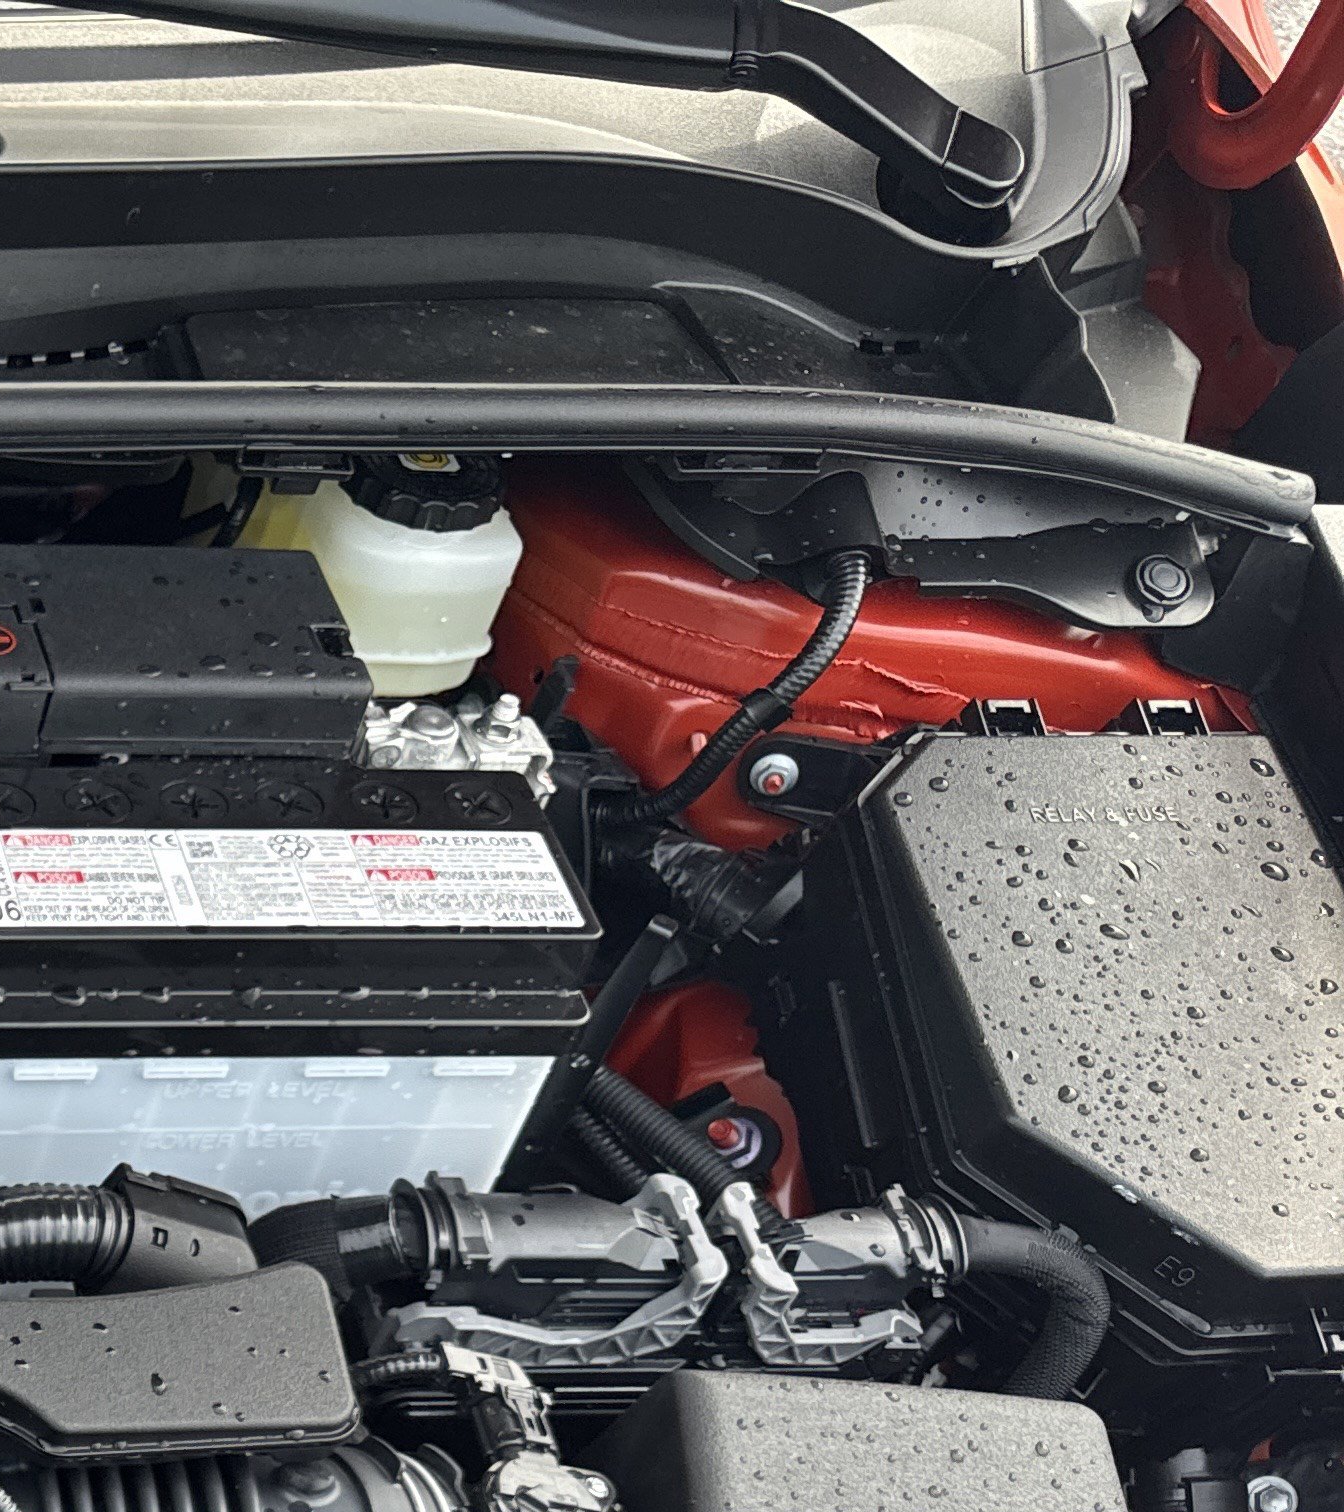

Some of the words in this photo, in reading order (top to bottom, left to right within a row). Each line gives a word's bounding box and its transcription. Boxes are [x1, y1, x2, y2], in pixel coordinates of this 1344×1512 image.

[1029, 807, 1096, 823] RELAY
[1105, 807, 1120, 822] &
[1123, 806, 1180, 822] FUSE
[72, 835, 116, 845] EXPLOSIVE
[118, 835, 147, 845] GASES
[419, 836, 450, 847] GAZ
[454, 836, 532, 847] EXPLOSIFS
[107, 896, 122, 905] DO
[126, 896, 146, 905] NOT
[23, 905, 43, 914] KEEP
[25, 913, 48, 922] KEEP
[491, 910, 576, 923] 345LN1-MF
[163, 1081, 253, 1099] UPPER
[267, 1081, 347, 1099] LEVEL
[146, 1131, 237, 1151] LOWER
[247, 1130, 323, 1148] LEVEL
[1153, 1255, 1196, 1288] E9
